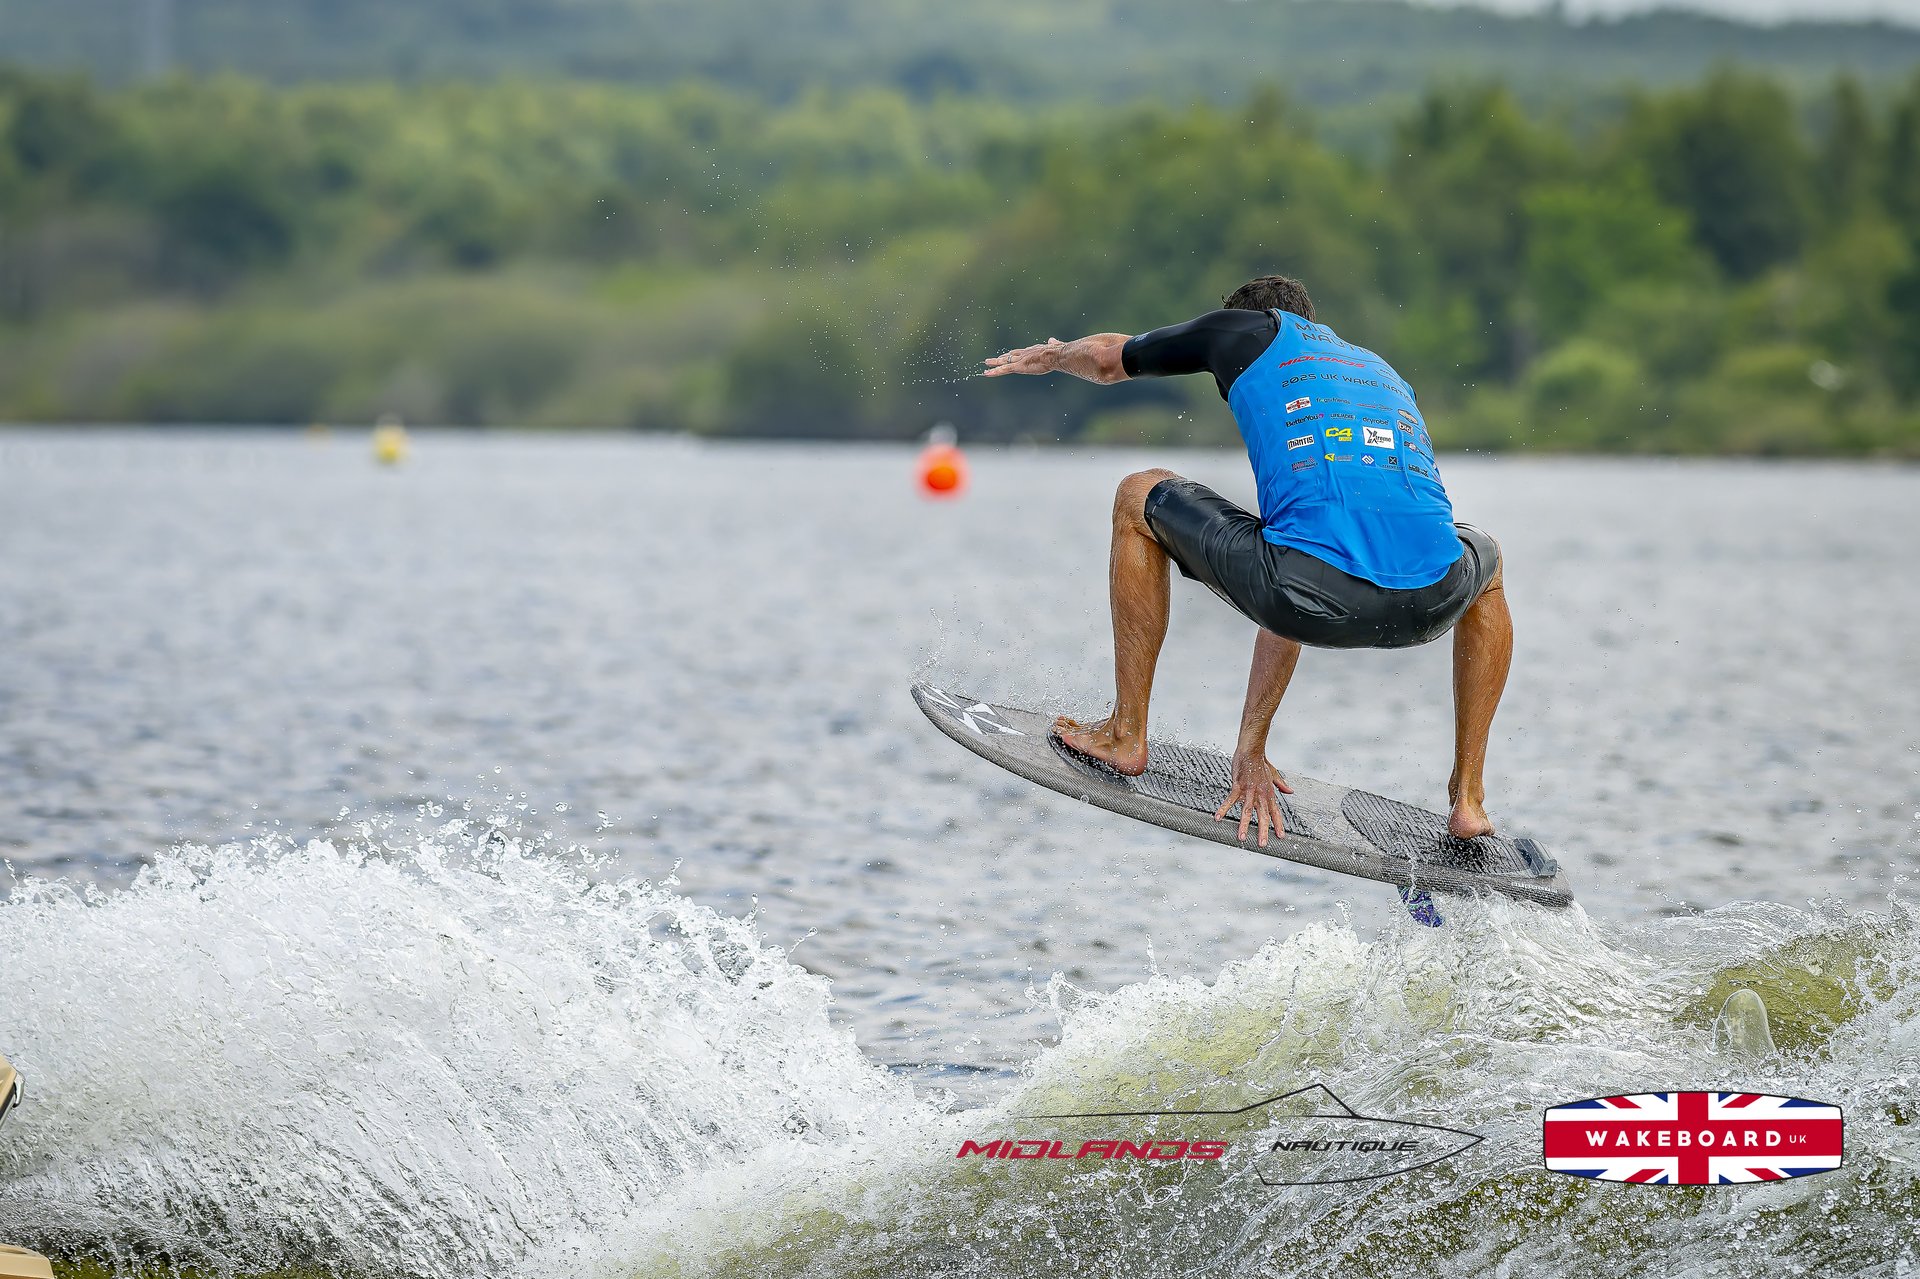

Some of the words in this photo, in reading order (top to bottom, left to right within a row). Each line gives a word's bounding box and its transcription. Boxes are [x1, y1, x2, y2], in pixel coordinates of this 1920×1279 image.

[1279, 356, 1366, 369] MIDLANDS
[1281, 373, 1317, 388] 2025
[1320, 373, 1339, 381] UK
[1342, 375, 1379, 388] WAKE
[1285, 414, 1319, 427] BetterYou
[1325, 427, 1353, 438] C4
[1287, 436, 1314, 449] MANTIS
